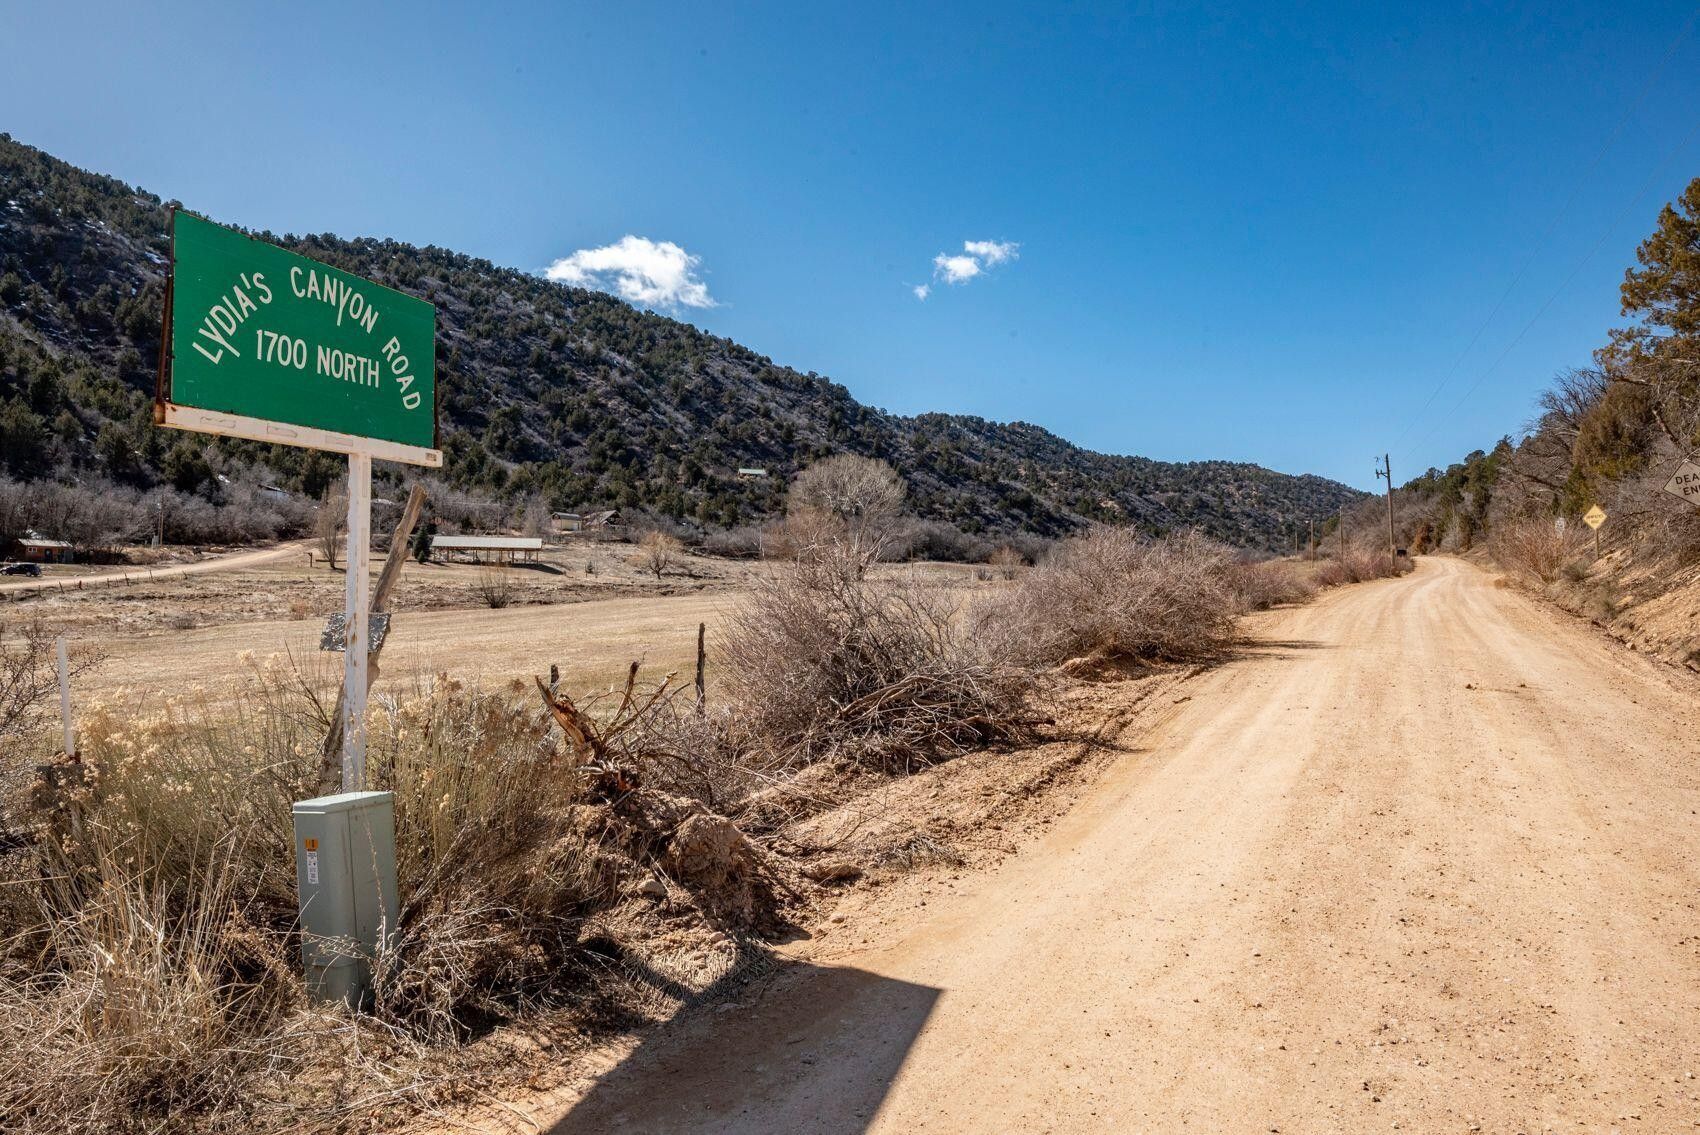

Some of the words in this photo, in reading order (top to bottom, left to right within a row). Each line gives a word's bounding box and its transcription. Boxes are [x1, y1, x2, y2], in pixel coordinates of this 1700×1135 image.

[192, 272, 273, 364] LYDIA'S
[290, 266, 379, 334] CANYON
[381, 335, 421, 410] ROAD
[256, 329, 307, 370] 1700
[316, 344, 380, 388] NORTH
[1675, 473, 1700, 485] DEA
[1683, 485, 1700, 496] EN
